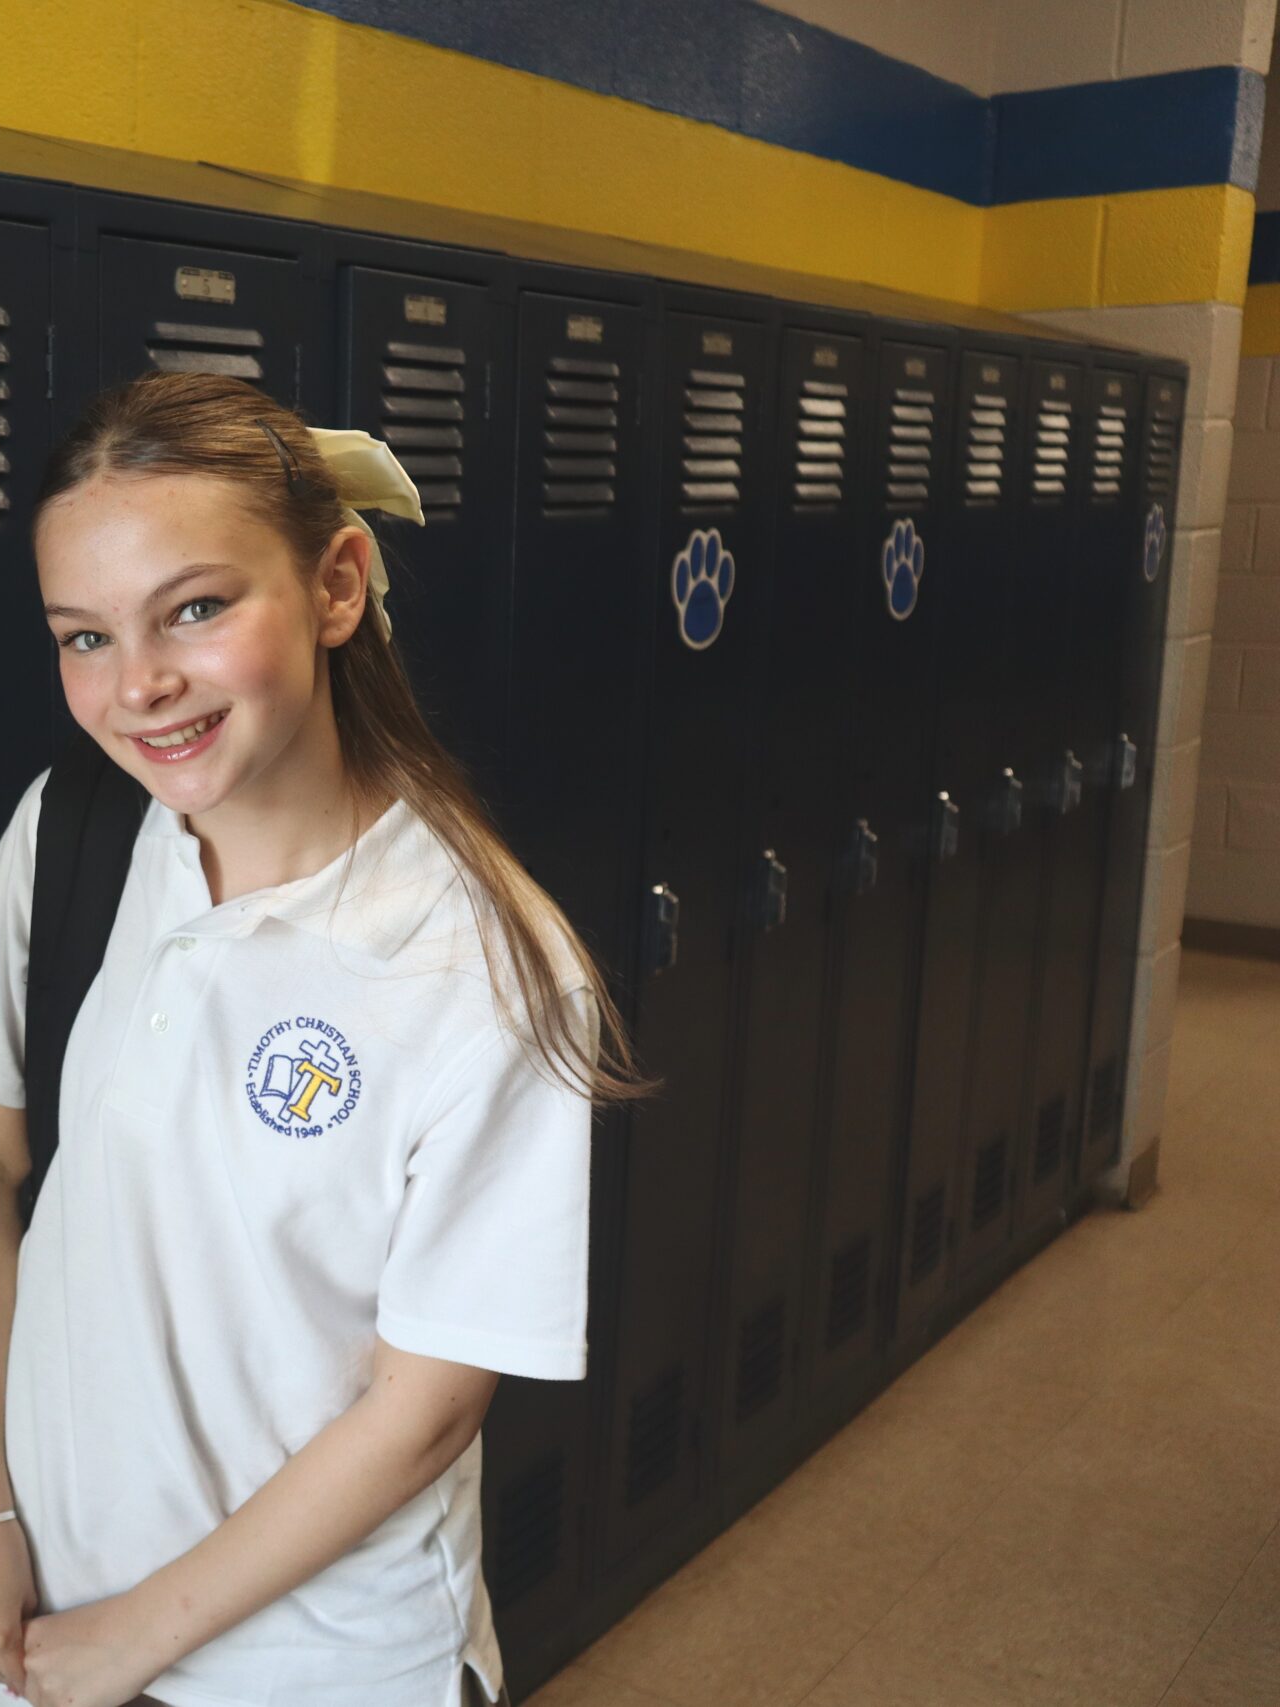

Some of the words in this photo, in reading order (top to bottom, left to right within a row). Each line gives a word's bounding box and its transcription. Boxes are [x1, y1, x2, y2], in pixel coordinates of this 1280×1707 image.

[247, 1019, 292, 1072] TIMOTHY
[295, 1016, 358, 1066] CHRISTIAN
[330, 1069, 362, 1125] SCHOOL
[287, 1060, 342, 1123] T
[246, 1082, 292, 1136] Established
[295, 1125, 323, 1139] 1949
